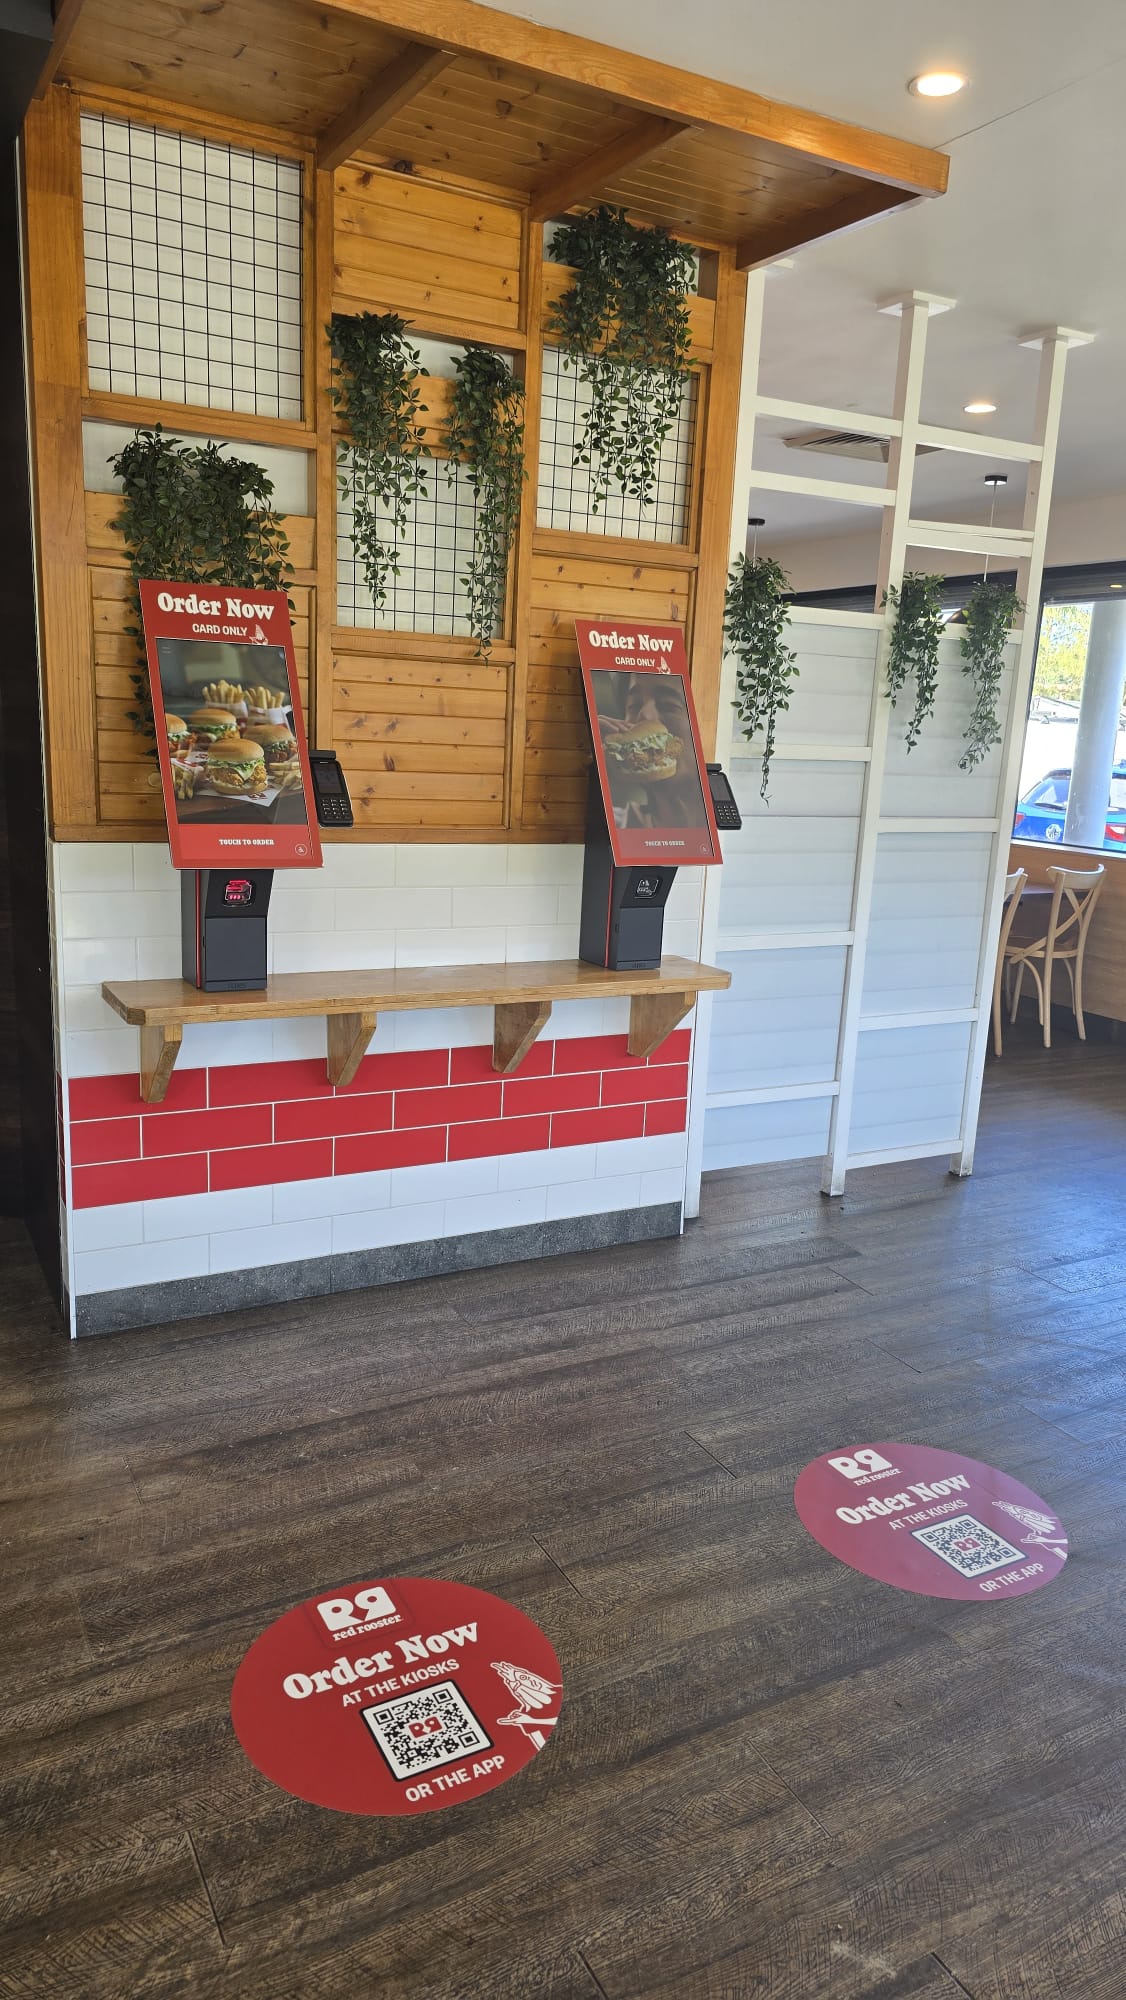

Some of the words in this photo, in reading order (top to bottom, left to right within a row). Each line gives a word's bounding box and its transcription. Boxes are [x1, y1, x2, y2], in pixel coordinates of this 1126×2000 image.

[157, 592, 221, 616] Order
[225, 598, 275, 620] Now
[192, 623, 220, 635] CARD
[222, 625, 247, 636] ONLY
[589, 630, 635, 650] Order
[637, 634, 674, 653] Now
[615, 656, 636, 666] CARD
[636, 658, 655, 667] ONLY
[853, 1474, 871, 1486] red
[868, 1467, 901, 1482] rooster
[836, 1492, 917, 1525] Order
[906, 1474, 971, 1502] Now
[888, 1519, 906, 1531] AT
[903, 1511, 930, 1525] THE
[927, 1499, 969, 1517] KIOSKS
[979, 1580, 1001, 1593] OR
[995, 1571, 1025, 1586] THE
[1021, 1562, 1045, 1577] APP
[332, 1625, 358, 1642] red
[358, 1613, 402, 1633] rooster
[283, 1650, 395, 1699] Order
[395, 1622, 478, 1663] Now
[342, 1690, 362, 1707] AT
[364, 1678, 401, 1699] THE
[400, 1658, 460, 1687] KIOSKS
[405, 1783, 434, 1802] OR
[431, 1768, 472, 1791] THE
[472, 1755, 505, 1778] APP
